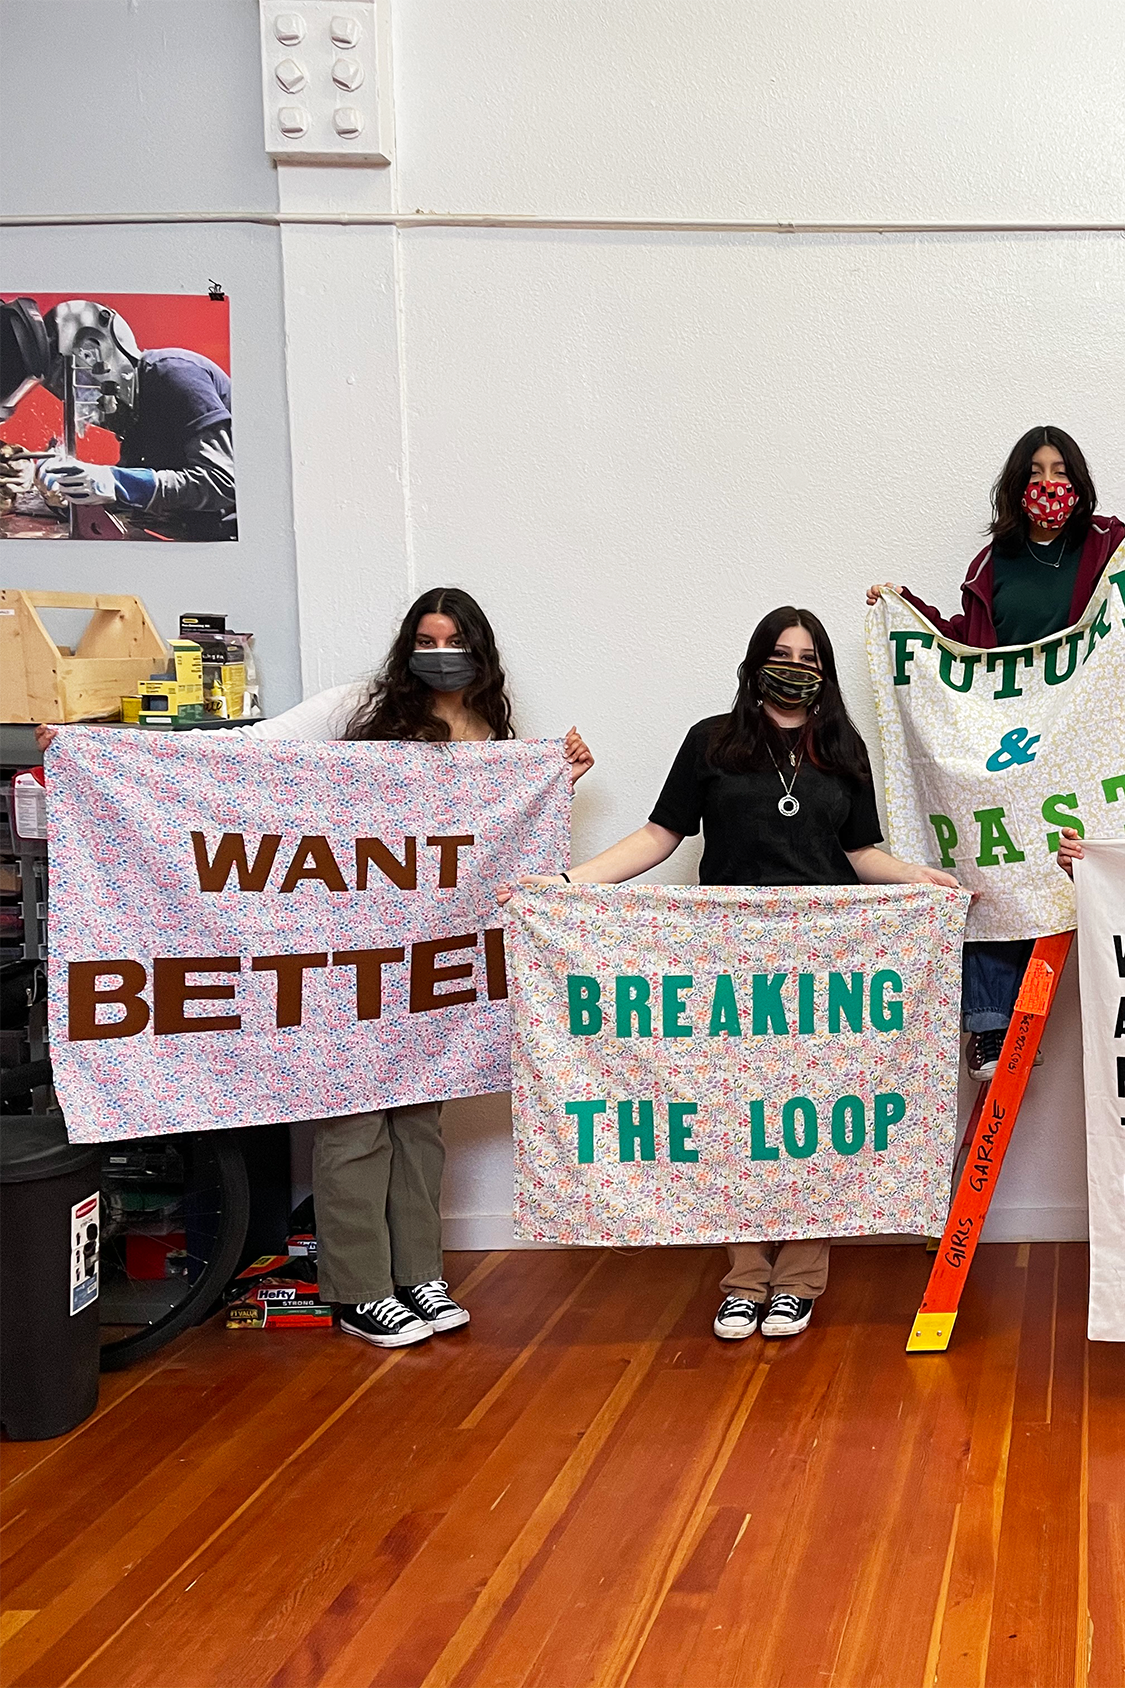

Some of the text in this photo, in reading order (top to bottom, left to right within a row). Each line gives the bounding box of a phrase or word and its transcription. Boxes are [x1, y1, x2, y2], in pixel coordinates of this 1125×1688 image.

[985, 727, 1042, 772] &
[190, 831, 474, 893] WANT
[567, 969, 904, 1038] BREAKING
[565, 1092, 906, 1164] THE LOOP
[944, 1098, 1006, 1269] GIRLS GARAGE
[258, 1289, 295, 1300] Hefty
